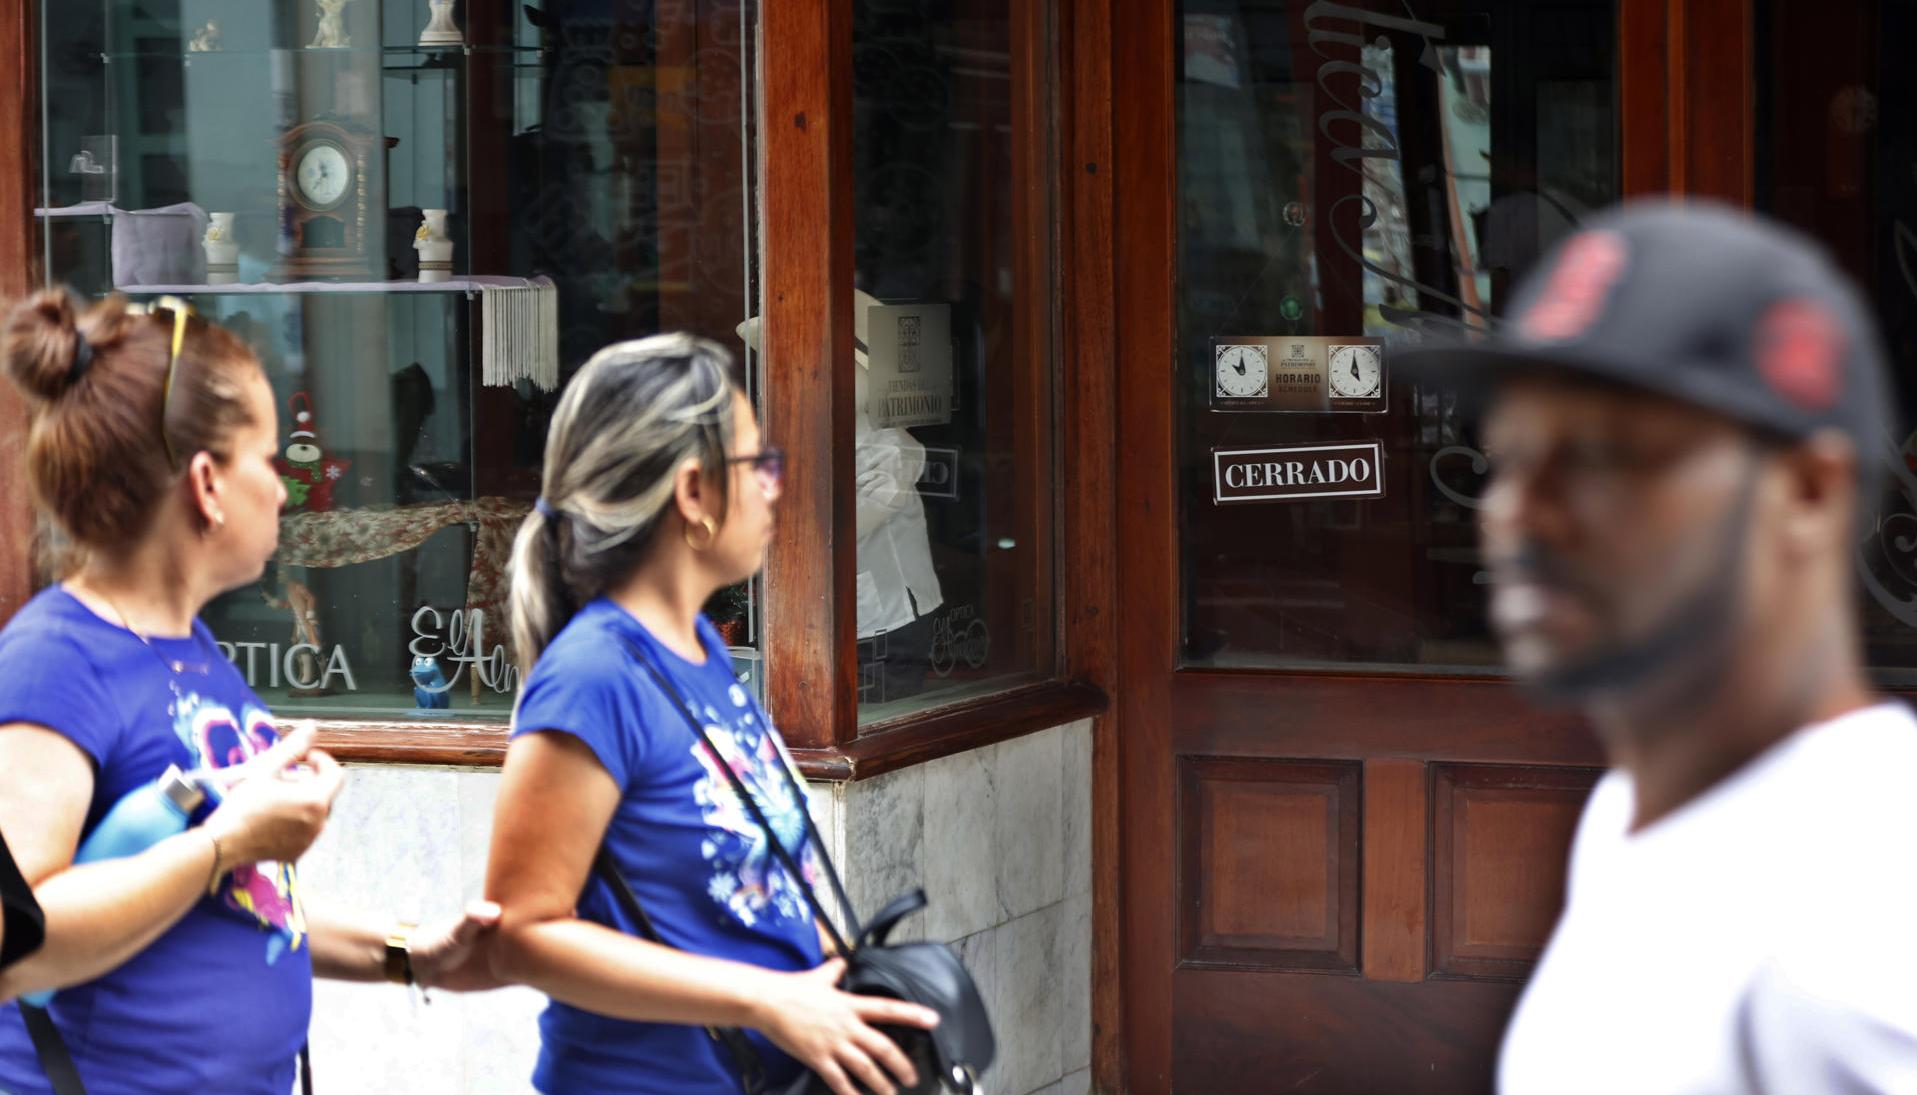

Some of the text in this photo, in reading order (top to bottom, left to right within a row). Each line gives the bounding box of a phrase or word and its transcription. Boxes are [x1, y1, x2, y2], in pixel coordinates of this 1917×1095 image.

[1303, 0, 1447, 183] tica
[1275, 373, 1321, 384] HORARIO
[878, 394, 943, 419] PATRIMONIO
[1225, 457, 1370, 489] CERRADO
